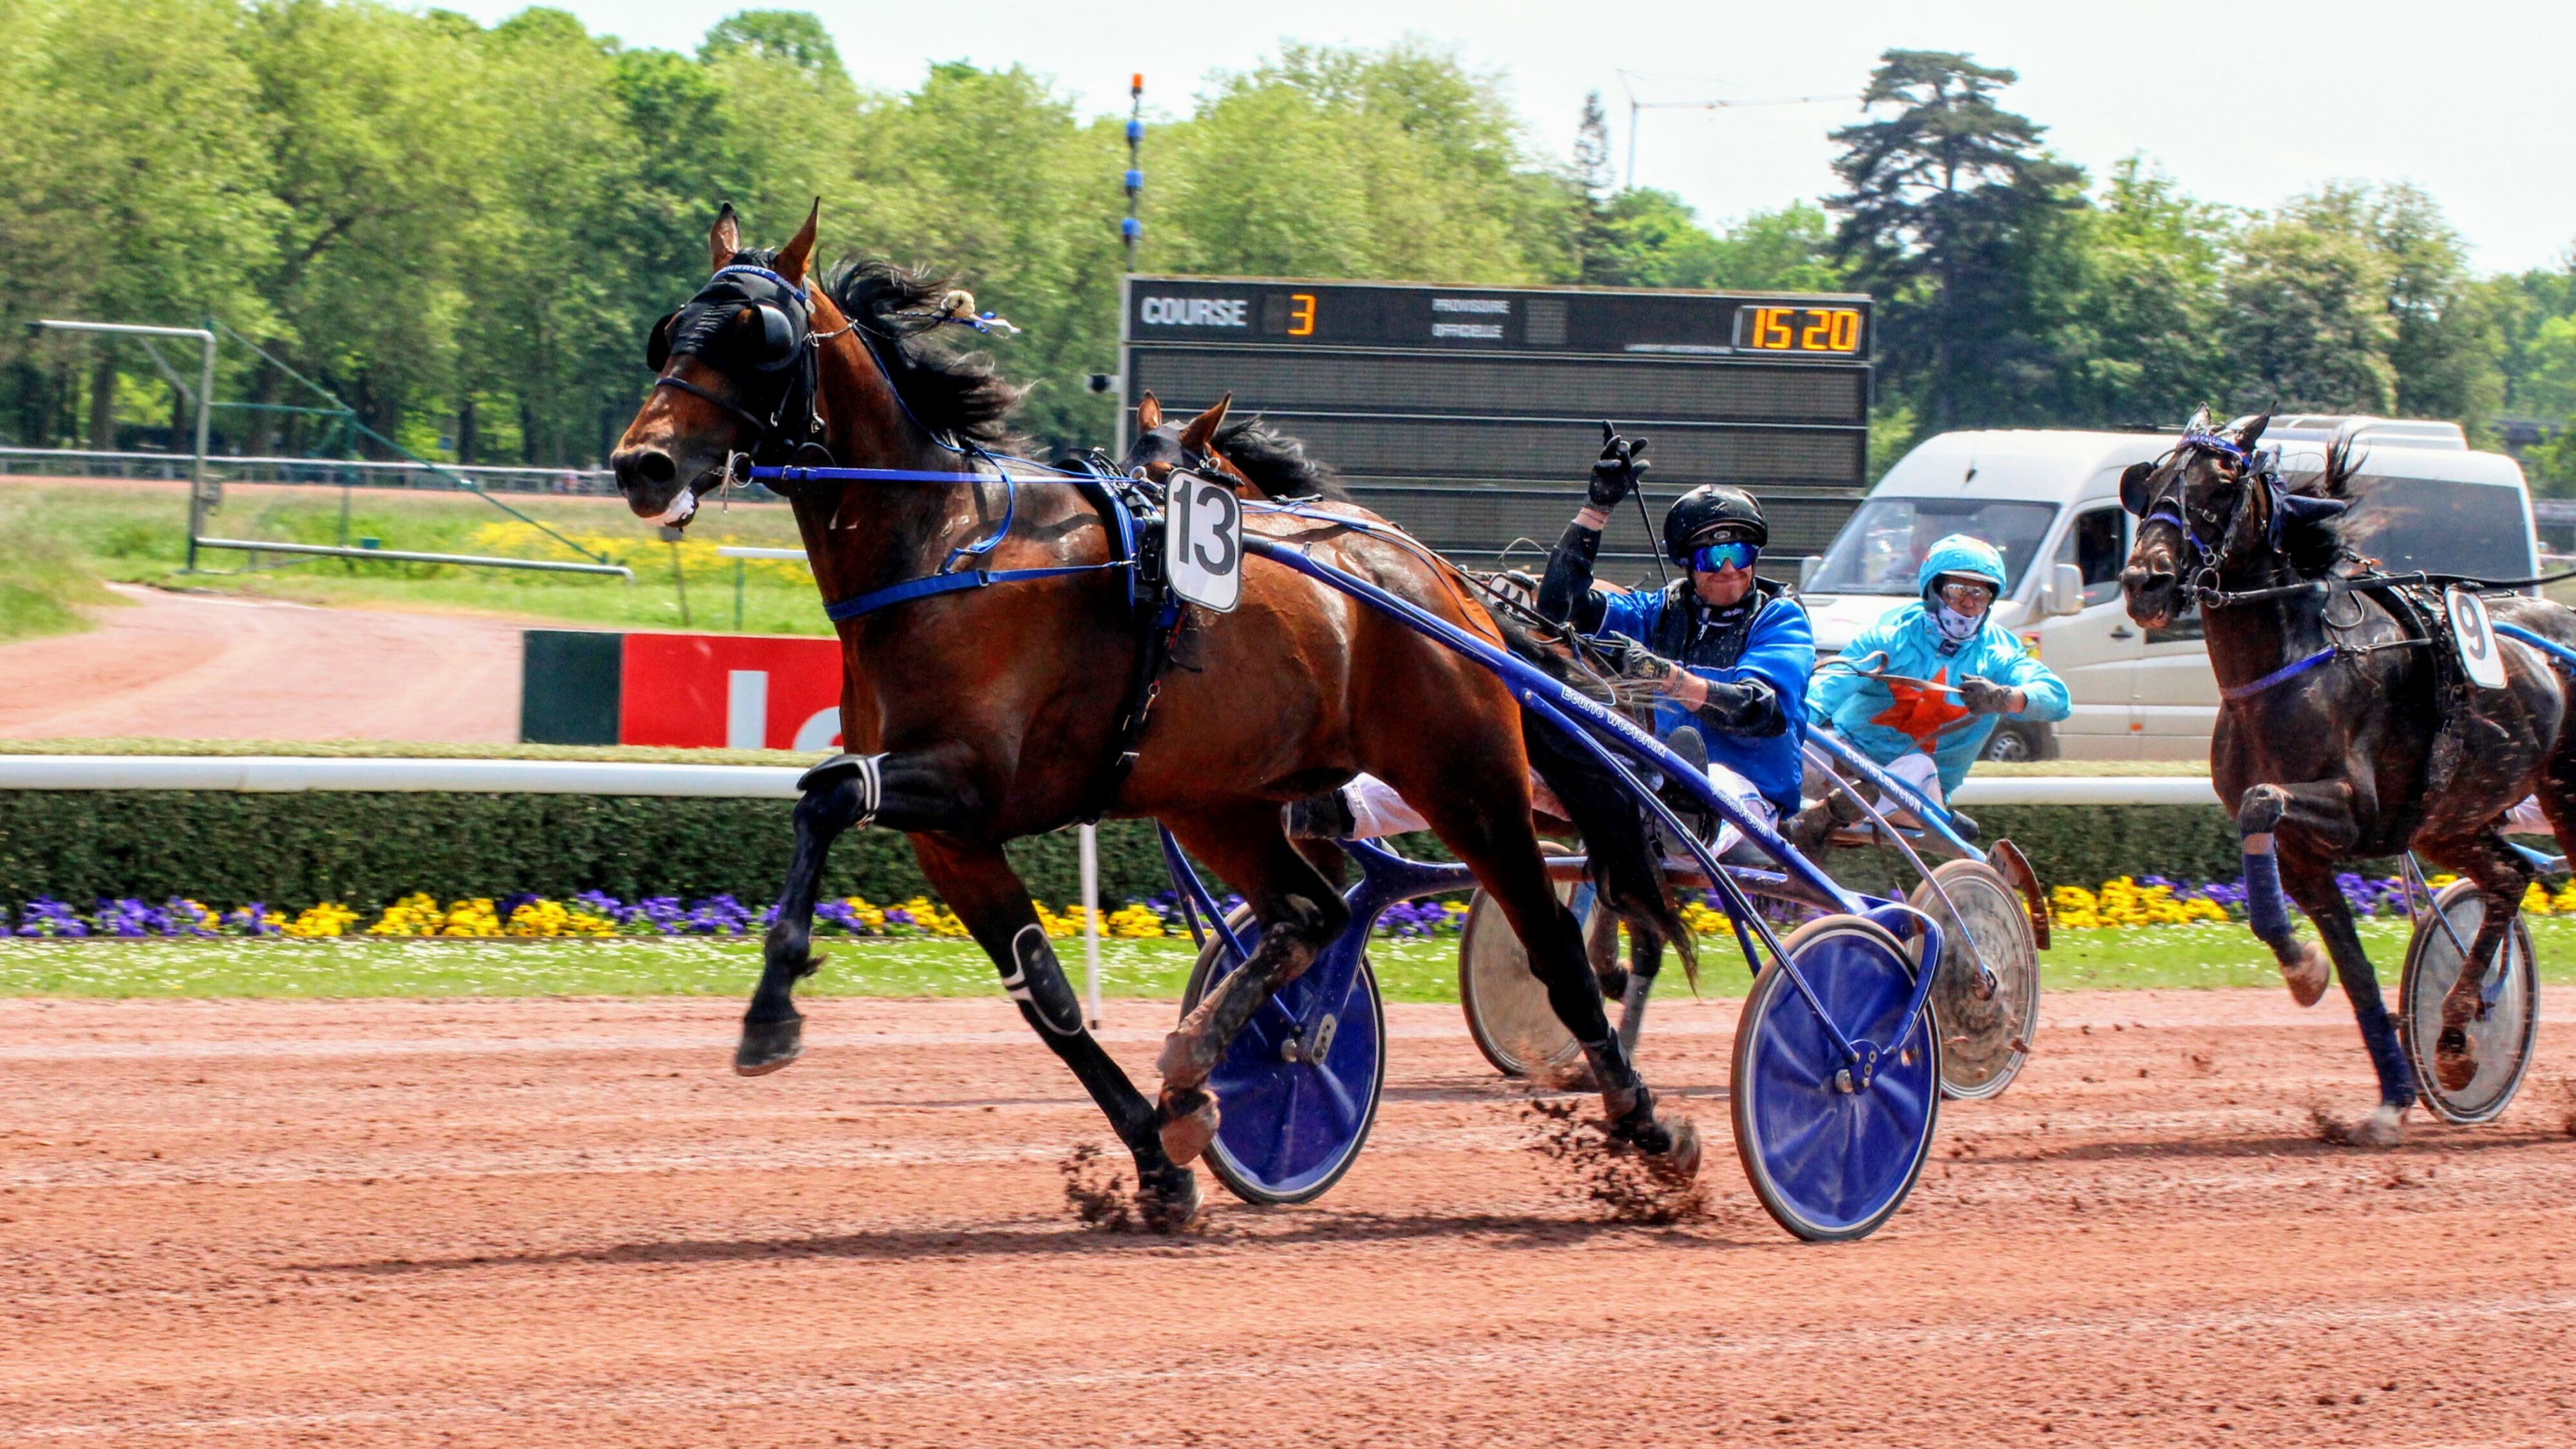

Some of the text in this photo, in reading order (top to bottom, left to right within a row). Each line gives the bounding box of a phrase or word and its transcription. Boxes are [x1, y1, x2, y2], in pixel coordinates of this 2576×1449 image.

[1142, 297, 1248, 327] COURSE
[1288, 294, 1316, 336] 3
[1752, 308, 1859, 351] 15 20
[2200, 435, 2226, 447] VALLON
[1173, 482, 1236, 575] 13
[2456, 594, 2486, 660] 9
[1561, 686, 1667, 759] Ecurie Westerink
